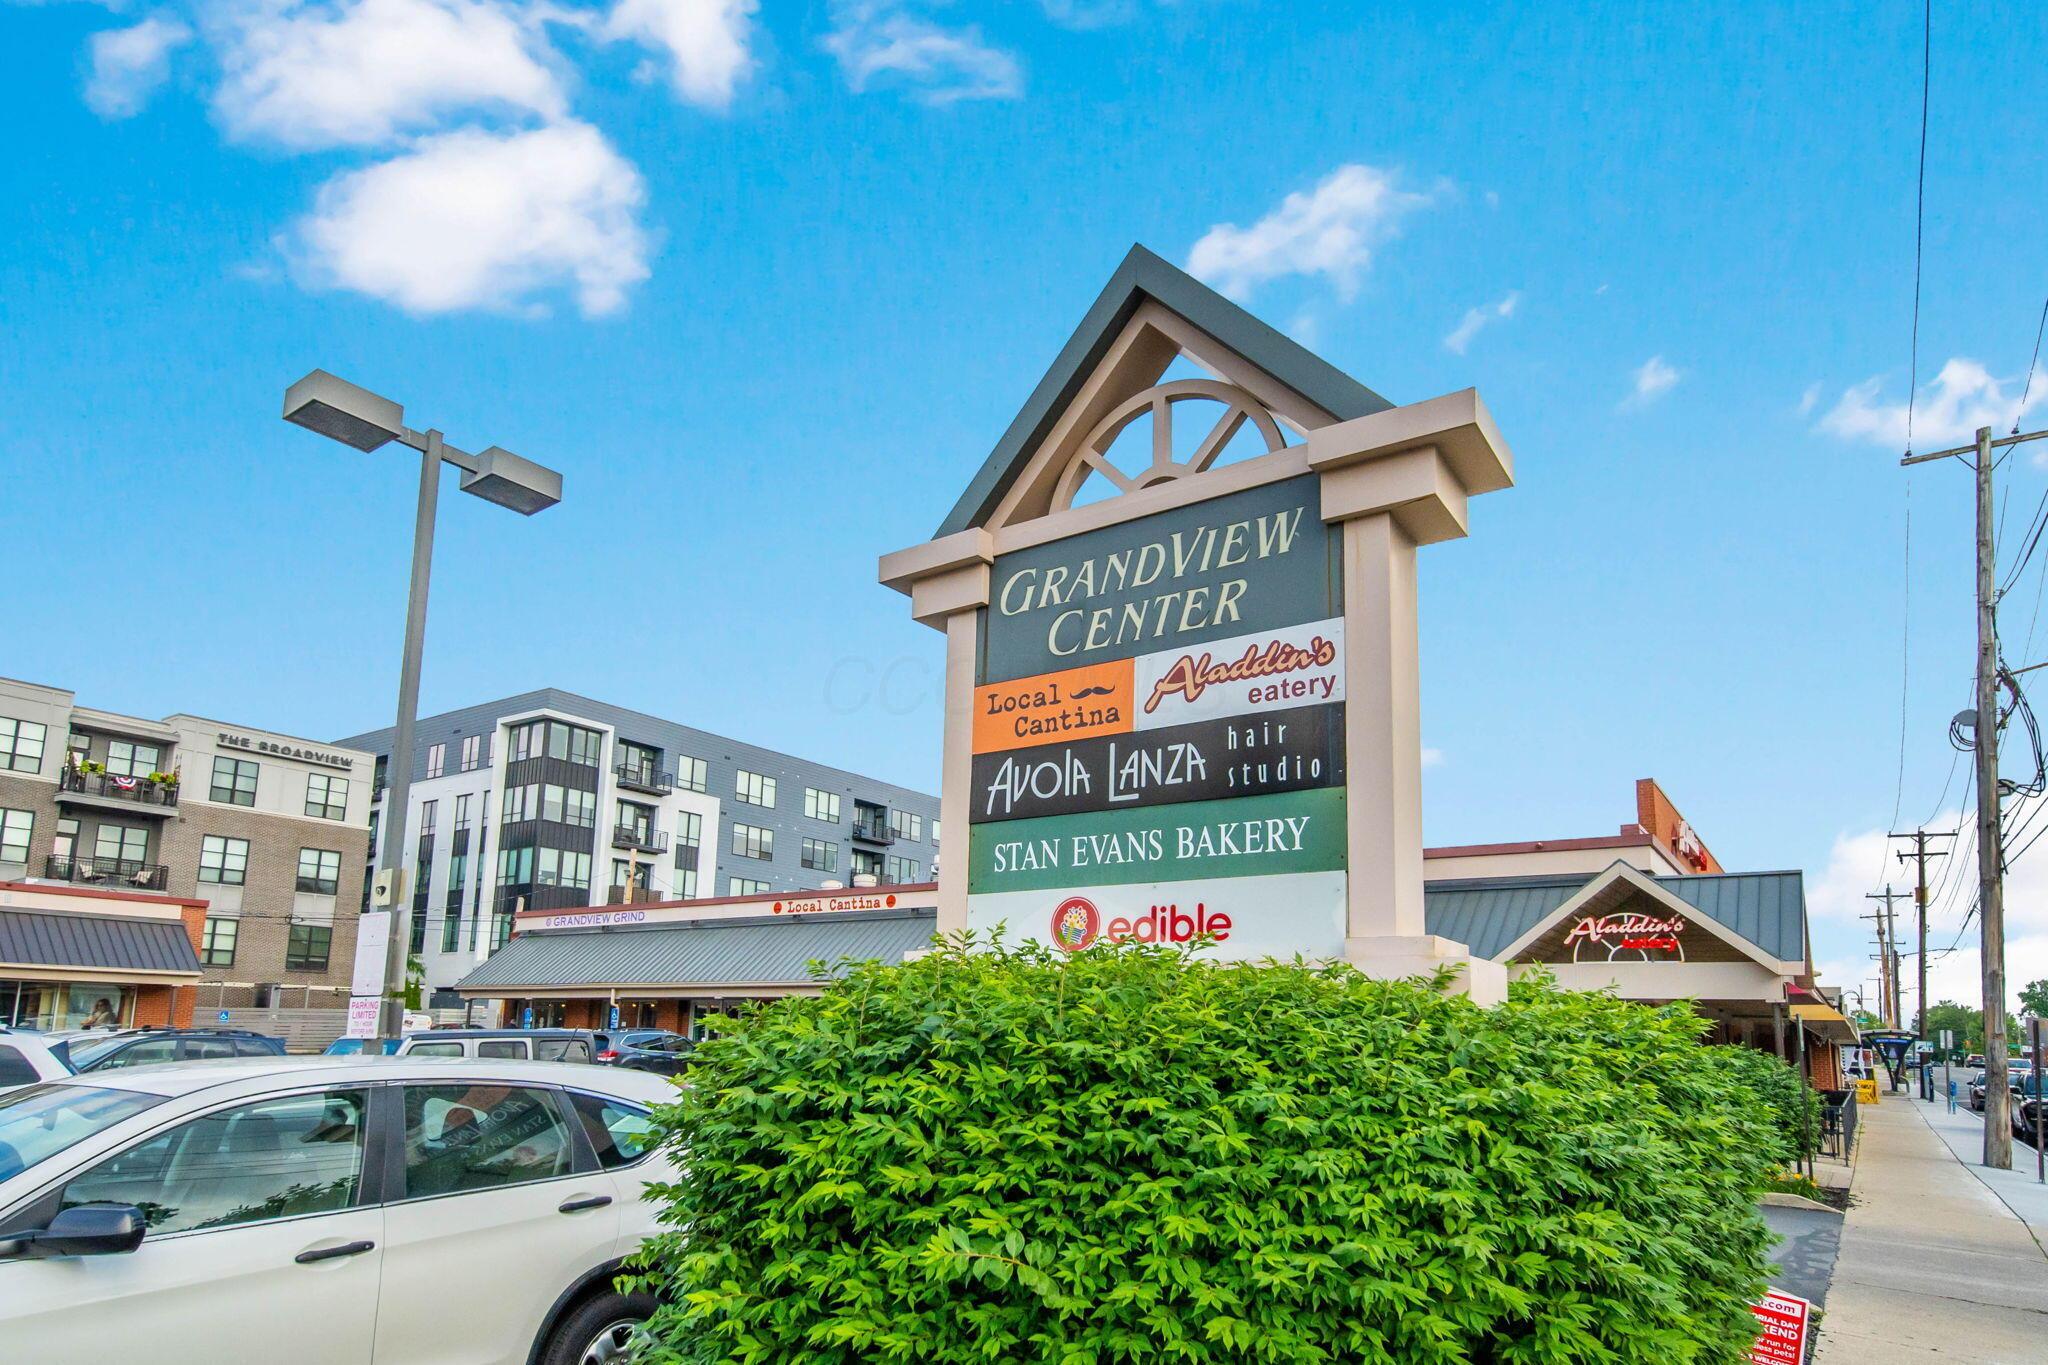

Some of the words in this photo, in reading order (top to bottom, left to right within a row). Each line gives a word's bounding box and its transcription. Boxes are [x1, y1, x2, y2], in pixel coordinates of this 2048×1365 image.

[1000, 506, 1305, 617] GRANDVIEW
[1047, 578, 1249, 657] CENTER
[1144, 635, 1336, 714] Aladdin's
[1247, 674, 1336, 704] eatery
[987, 683, 1062, 715] Local
[1014, 706, 1121, 738] Cantina
[1227, 722, 1287, 751] hair
[218, 733, 250, 748] THE
[258, 741, 354, 767] BROADVIEW
[1108, 742, 1206, 802] LANZA
[1228, 755, 1321, 787] studio
[994, 838, 1061, 873] STAN
[1071, 829, 1163, 867] EVANS
[1175, 816, 1311, 860] BAKERY
[553, 913, 611, 927] GRANDVIEW
[613, 911, 645, 923] GRIND
[787, 899, 823, 913] Local
[829, 896, 881, 911] Cantina
[1107, 902, 1232, 944] edible
[1563, 915, 1686, 945] Aladdin's
[351, 1000, 379, 1010] PARKING
[351, 1010, 377, 1020] LIMITED
[1760, 1300, 1796, 1315] .com
[1780, 1320, 1800, 1330] DAY
[1766, 1338, 1781, 1348] run
[1783, 1342, 1796, 1352] for
